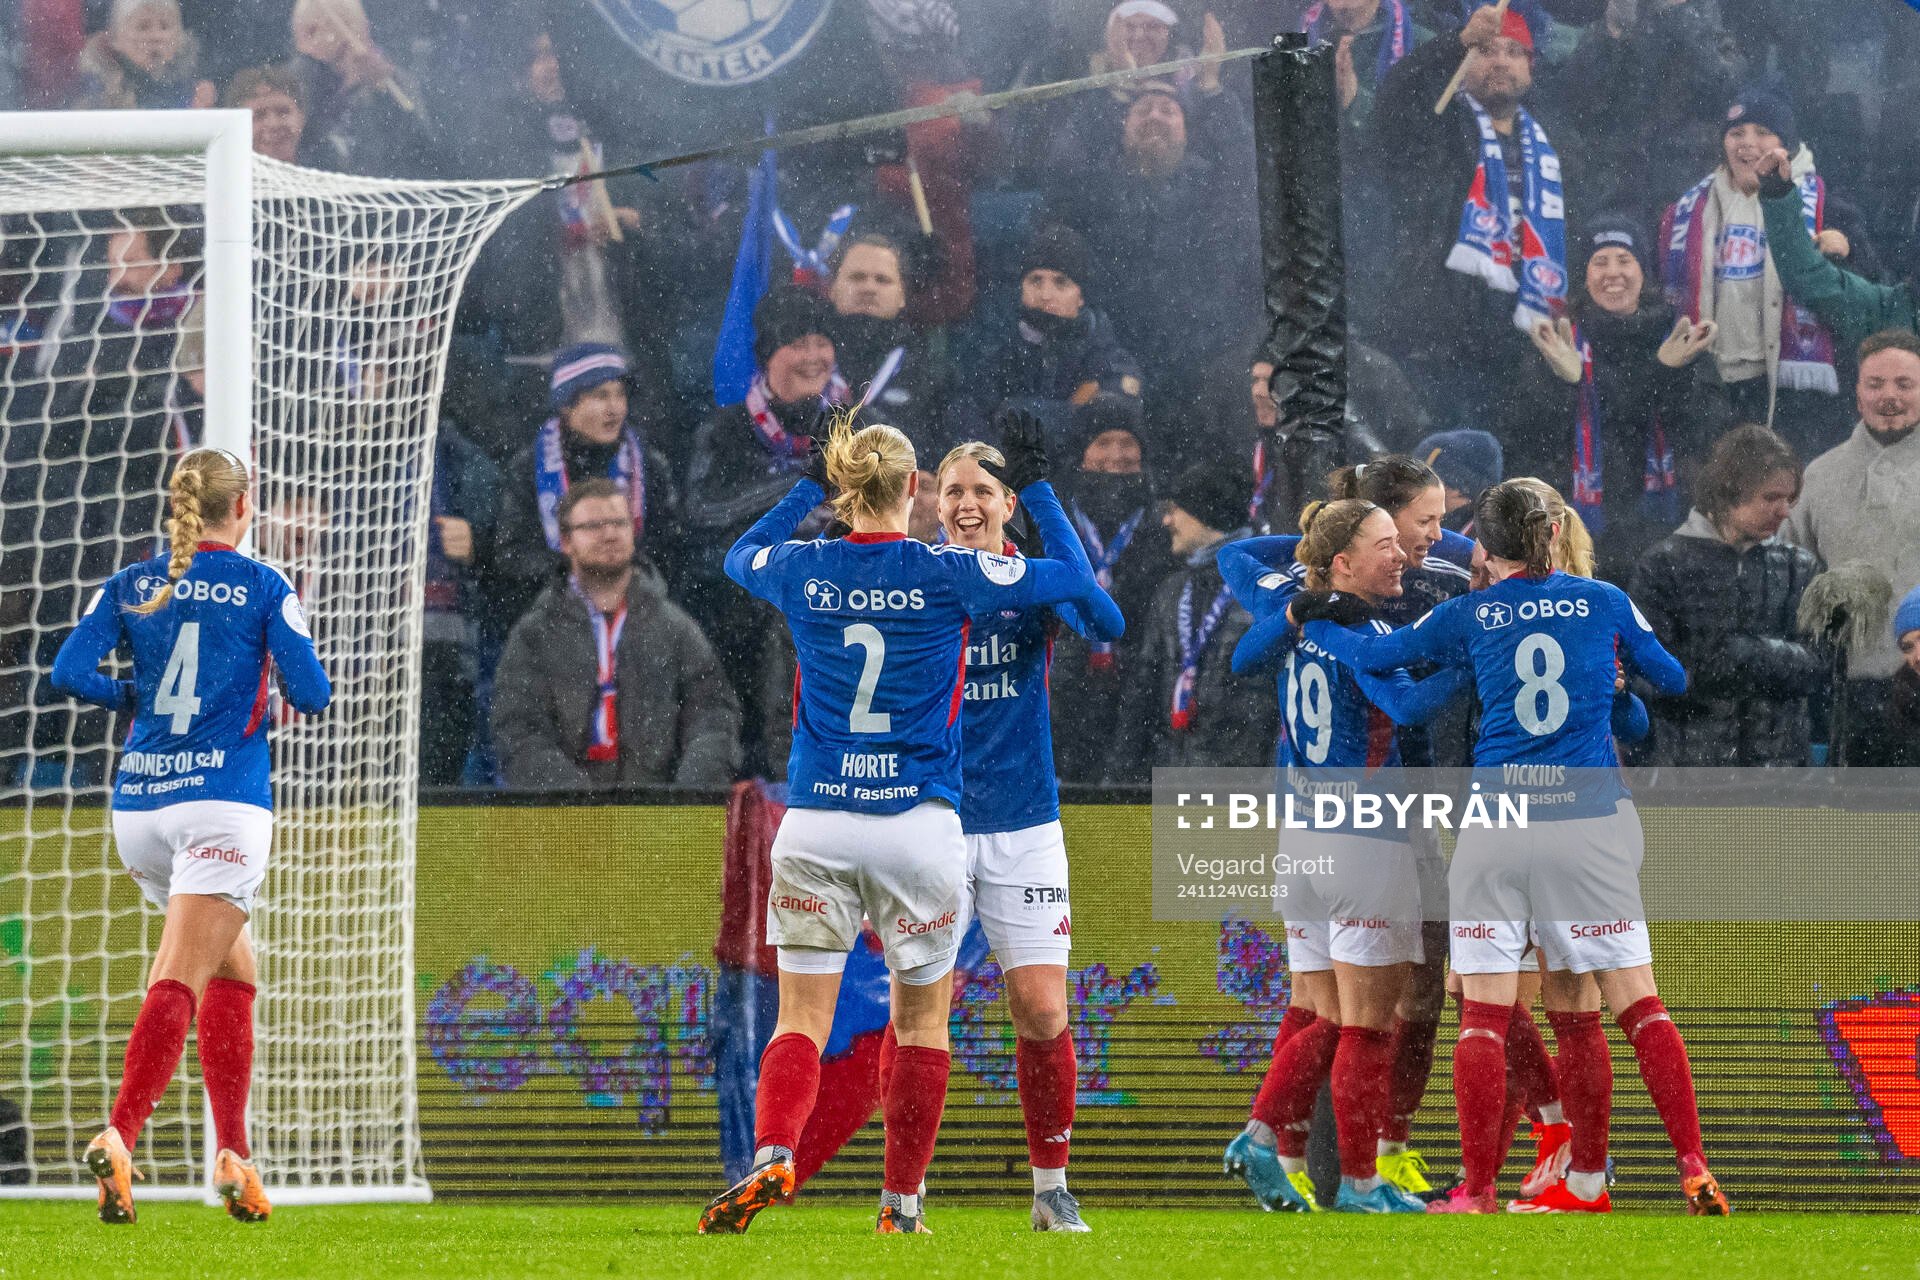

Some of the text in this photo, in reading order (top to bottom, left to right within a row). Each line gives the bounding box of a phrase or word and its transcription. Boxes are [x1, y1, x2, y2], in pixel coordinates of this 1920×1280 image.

[645, 36, 775, 81] ENTER
[174, 578, 249, 607] OBOS
[848, 588, 926, 611] OBOS
[1518, 598, 1590, 621] OBOS
[965, 634, 1019, 666] rila
[154, 622, 202, 735] 4
[843, 623, 893, 734] 2
[963, 671, 1020, 701] ank
[1514, 632, 1570, 737] 8
[1284, 650, 1333, 765] 19
[840, 752, 899, 778] HØRTE
[1503, 763, 1566, 787] VICKIUS
[120, 775, 205, 795] mot rasisme
[813, 781, 919, 800] mot rasisme
[896, 911, 957, 935] Scandic
[1569, 918, 1636, 940] Scandic
